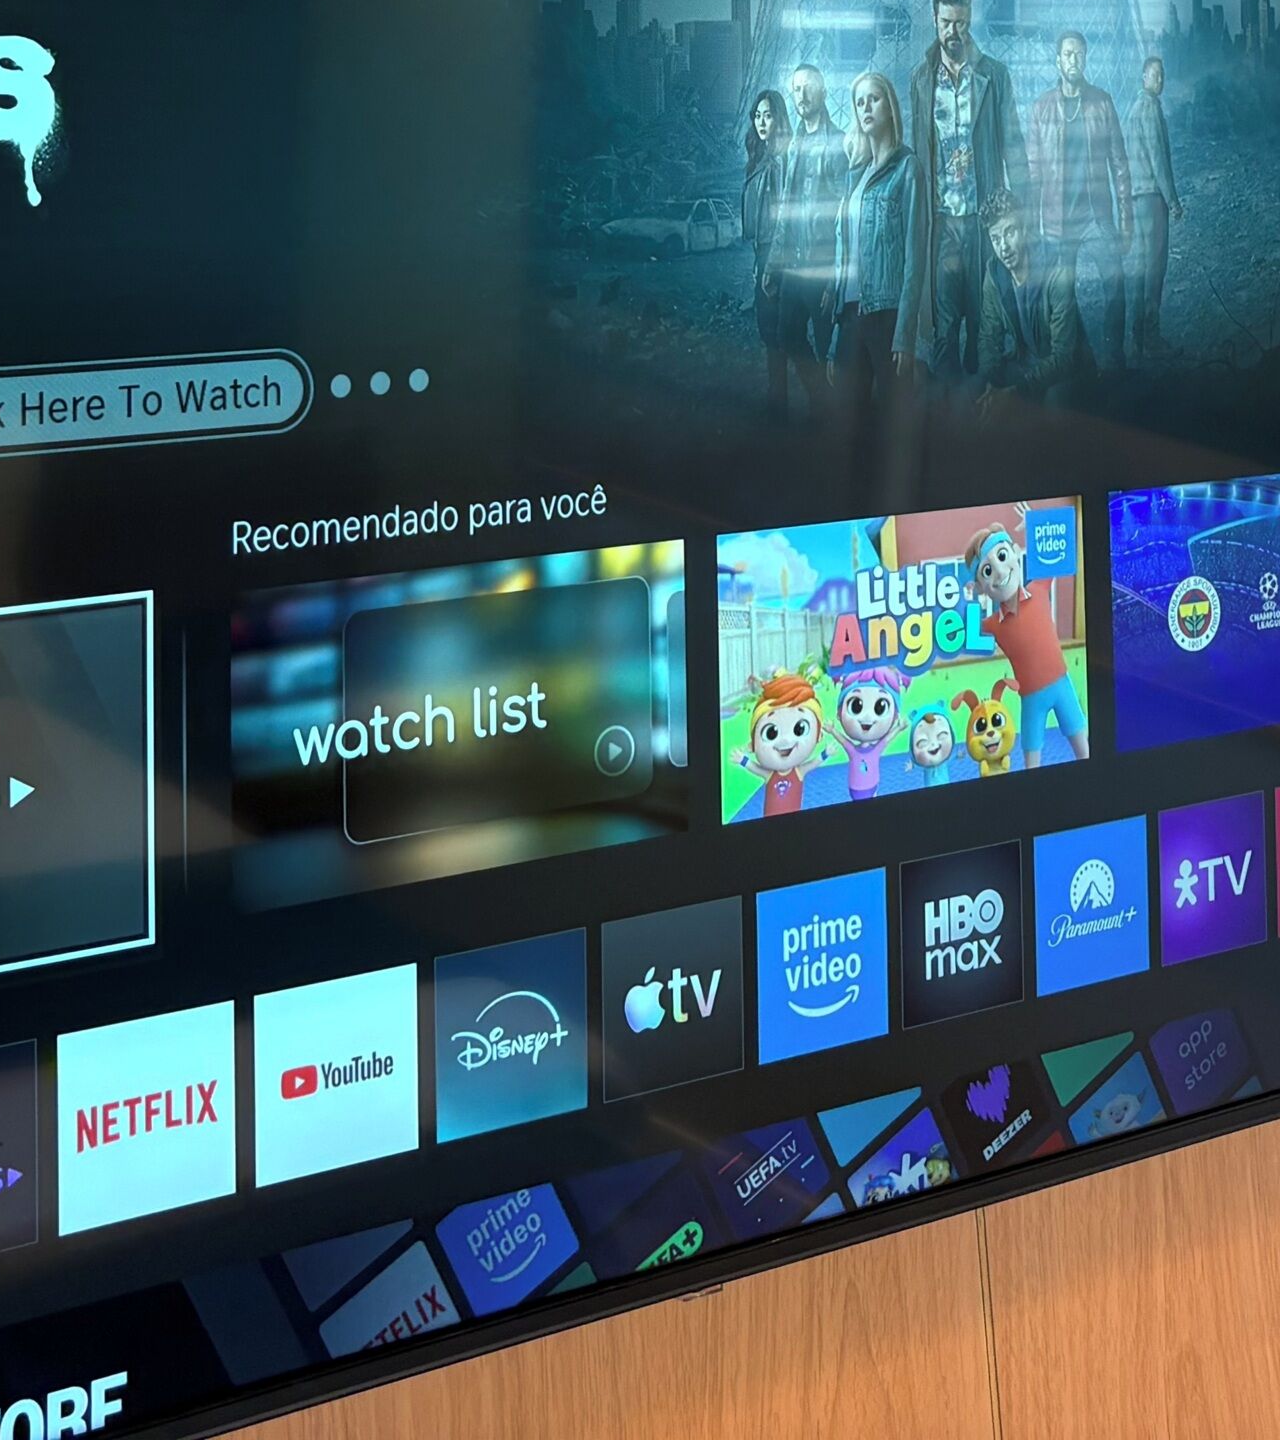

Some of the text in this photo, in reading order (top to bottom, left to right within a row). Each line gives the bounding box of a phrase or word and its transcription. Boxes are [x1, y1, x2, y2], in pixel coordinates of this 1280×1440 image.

[20, 391, 106, 426] Here
[118, 384, 163, 418] To
[176, 374, 282, 414] Watch
[232, 483, 608, 555] Recomendado para você
[1034, 521, 1066, 540] prime
[1036, 537, 1067, 554] video
[856, 563, 960, 620] Little
[293, 681, 548, 766] watch list
[1198, 850, 1253, 901] TV
[783, 913, 862, 961] prime
[924, 888, 1004, 947] HBO
[1047, 905, 1138, 948] Paramount+
[785, 953, 862, 992] video
[925, 935, 1003, 981] max
[667, 966, 722, 1023] tv
[1178, 1019, 1213, 1059] app
[321, 1052, 394, 1089] YouTube
[1184, 1040, 1228, 1091] store
[76, 1079, 218, 1154] NETFLIX
[983, 1109, 1032, 1162] DEEZER
[735, 1139, 798, 1200] UEFA.tv
[466, 1187, 532, 1257] prime
[478, 1212, 542, 1273] video
